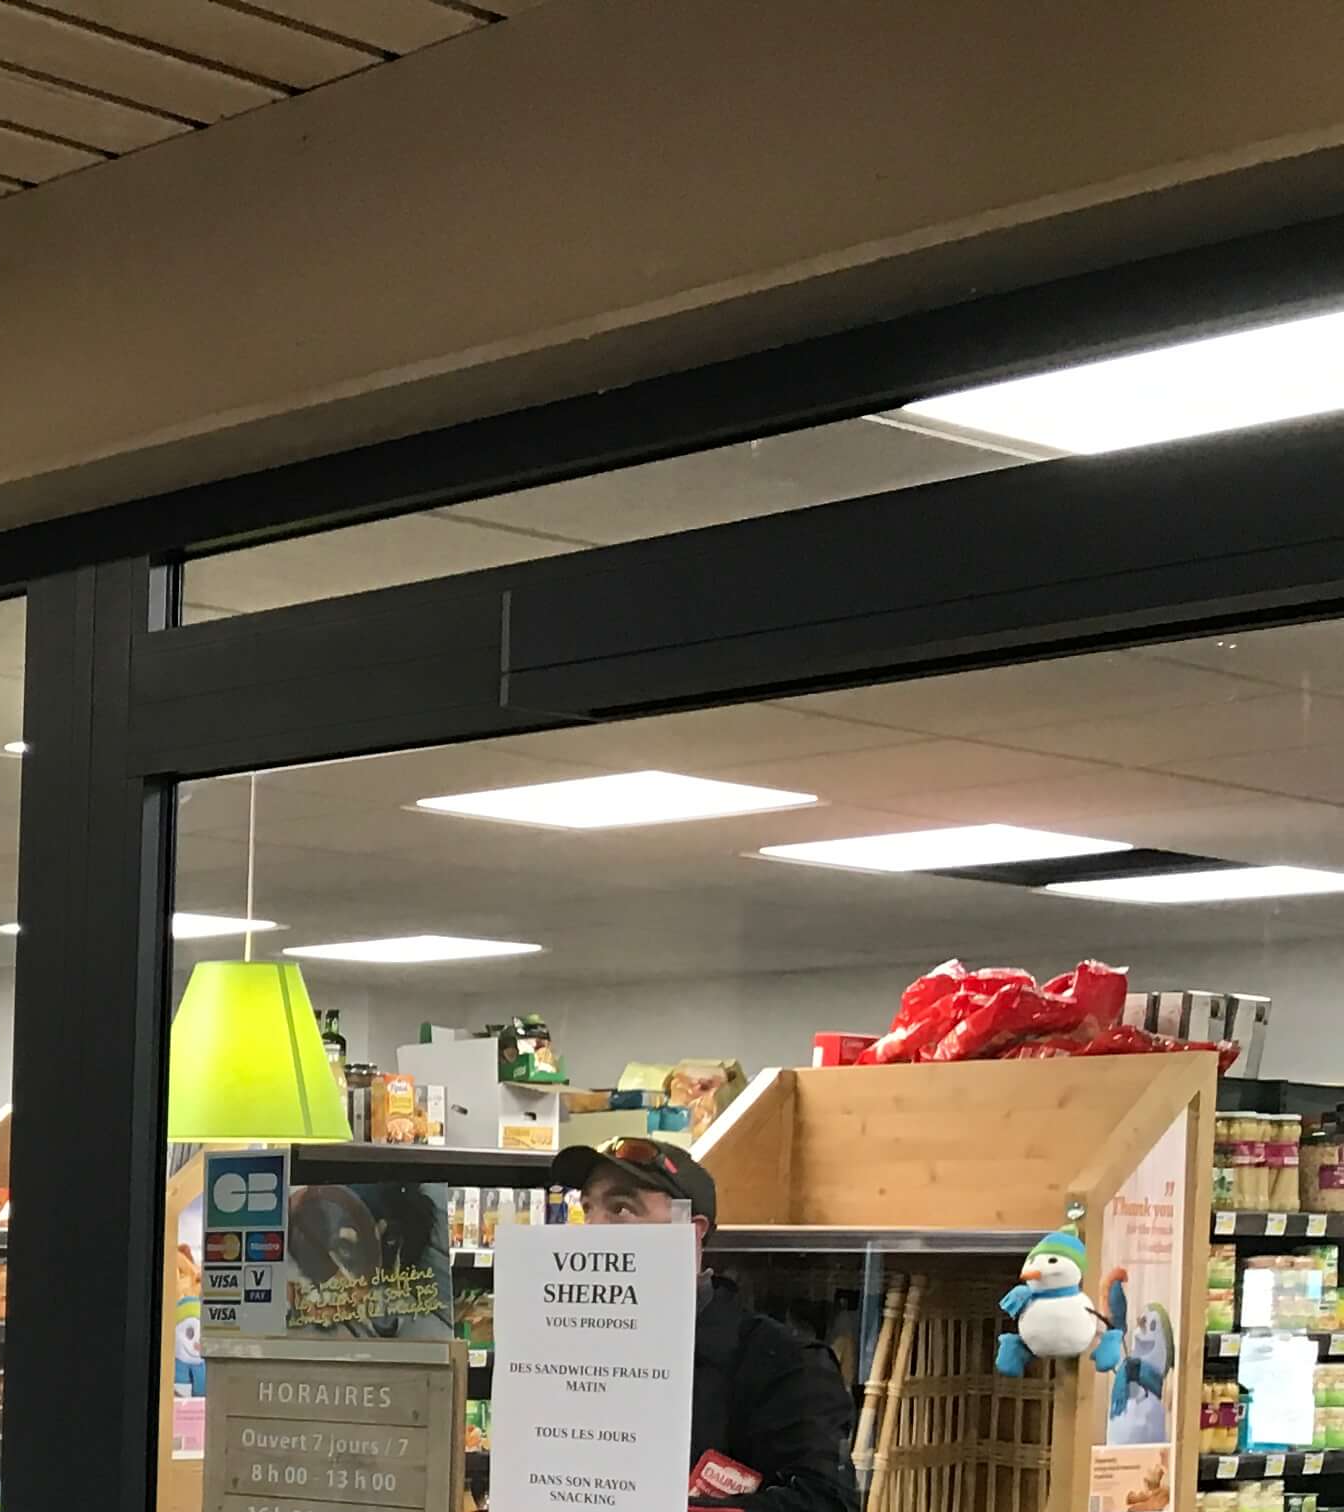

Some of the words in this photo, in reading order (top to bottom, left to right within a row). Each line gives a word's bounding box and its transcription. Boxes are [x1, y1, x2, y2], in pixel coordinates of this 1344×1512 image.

[552, 1252, 637, 1273] VOTRE
[209, 1274, 238, 1288] VISA
[252, 1270, 265, 1286] V
[544, 1284, 639, 1305] SHERPA
[209, 1307, 236, 1320] VISA
[545, 1316, 577, 1328] VOUS
[581, 1317, 638, 1330] PROPOSE
[509, 1362, 532, 1373] DES
[534, 1364, 609, 1377] SANDWICHS
[612, 1367, 649, 1379] FRAIS
[652, 1368, 670, 1380] DU
[259, 1382, 392, 1408] HORAIRES
[566, 1381, 607, 1393] MATIN
[242, 1429, 307, 1451] Ouvert
[313, 1434, 324, 1450] 7
[328, 1436, 379, 1457] jours
[399, 1439, 409, 1456] 7
[535, 1426, 568, 1439] TOUS
[571, 1428, 594, 1440] LES
[597, 1430, 637, 1443] JOURS
[251, 1464, 261, 1481] 8
[268, 1465, 279, 1482] h
[285, 1467, 307, 1485] 00
[326, 1470, 348, 1488] 13
[355, 1471, 366, 1489] h
[372, 1474, 396, 1492] 00
[529, 1473, 562, 1486] DANS
[565, 1475, 591, 1488] SON
[594, 1478, 636, 1492] RAYON
[549, 1490, 616, 1506] SNACKING
